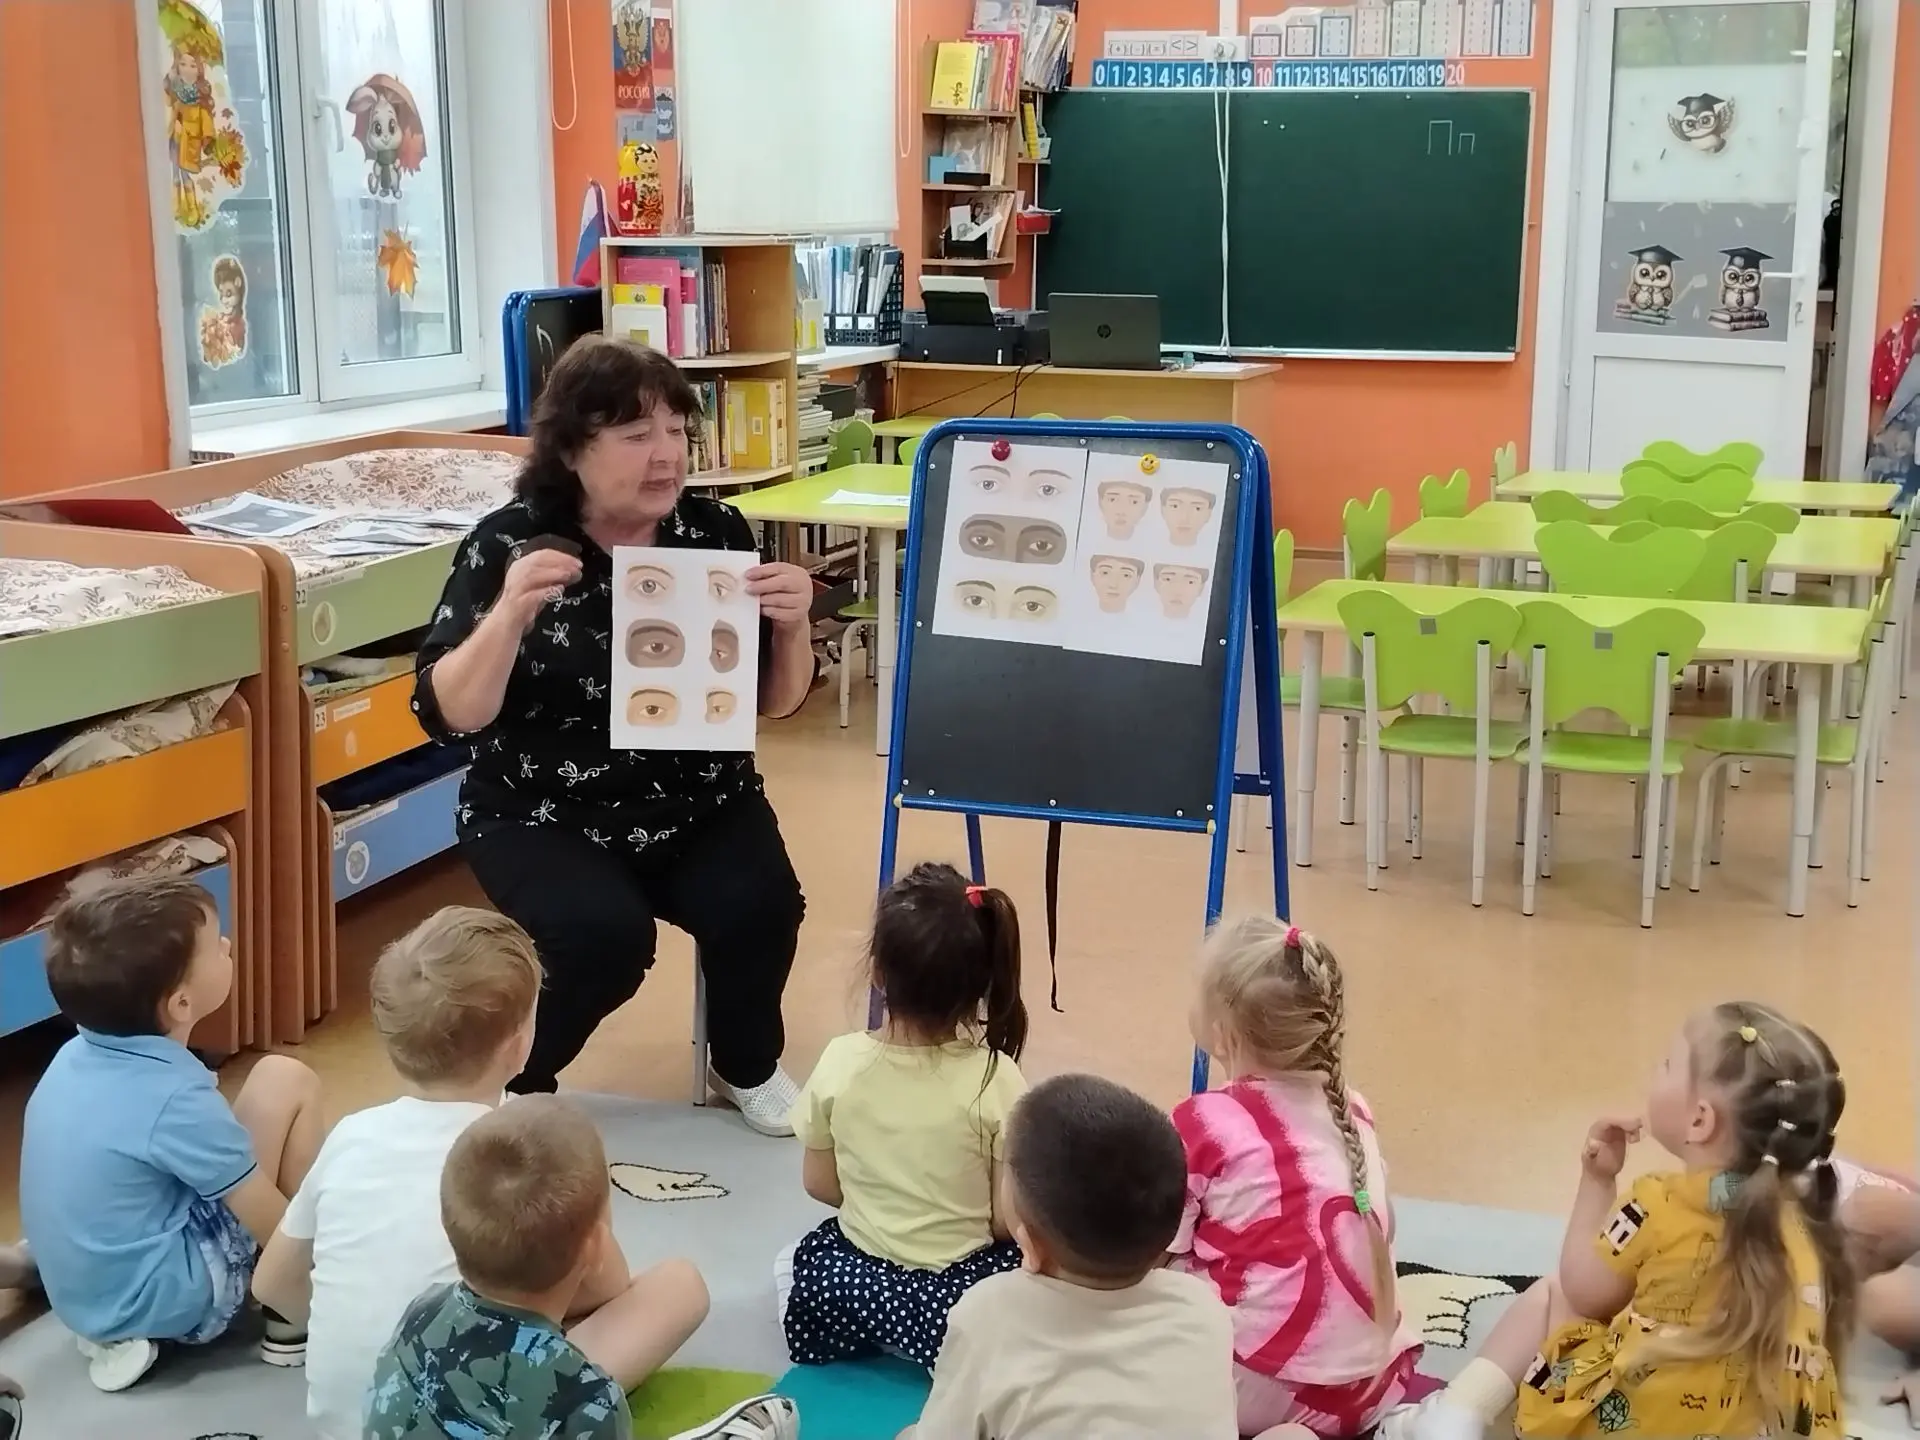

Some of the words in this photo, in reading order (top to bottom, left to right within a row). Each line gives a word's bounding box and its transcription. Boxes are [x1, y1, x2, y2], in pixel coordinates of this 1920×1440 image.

[1095, 64, 1105, 85] 0
[1112, 65, 1120, 86] 1
[1126, 66, 1137, 86] 2
[1143, 67, 1152, 87] 3
[1158, 67, 1170, 87] 4
[1175, 67, 1185, 87] 5
[1192, 68, 1202, 87] 6
[1241, 67, 1252, 87] 9
[1256, 67, 1272, 87] 10
[1276, 66, 1290, 87] 11
[1294, 67, 1311, 87] 12
[1313, 67, 1330, 87] 13
[1332, 67, 1349, 87] 14
[1351, 66, 1368, 87] 15
[1370, 66, 1388, 87] 16
[1389, 65, 1406, 87] 17
[1408, 65, 1426, 86] 18
[1428, 65, 1446, 86] 19
[1447, 63, 1465, 85] 20
[618, 85, 650, 99] РОССИЯ
[315, 711, 326, 728] 23
[334, 829, 344, 845] 24
